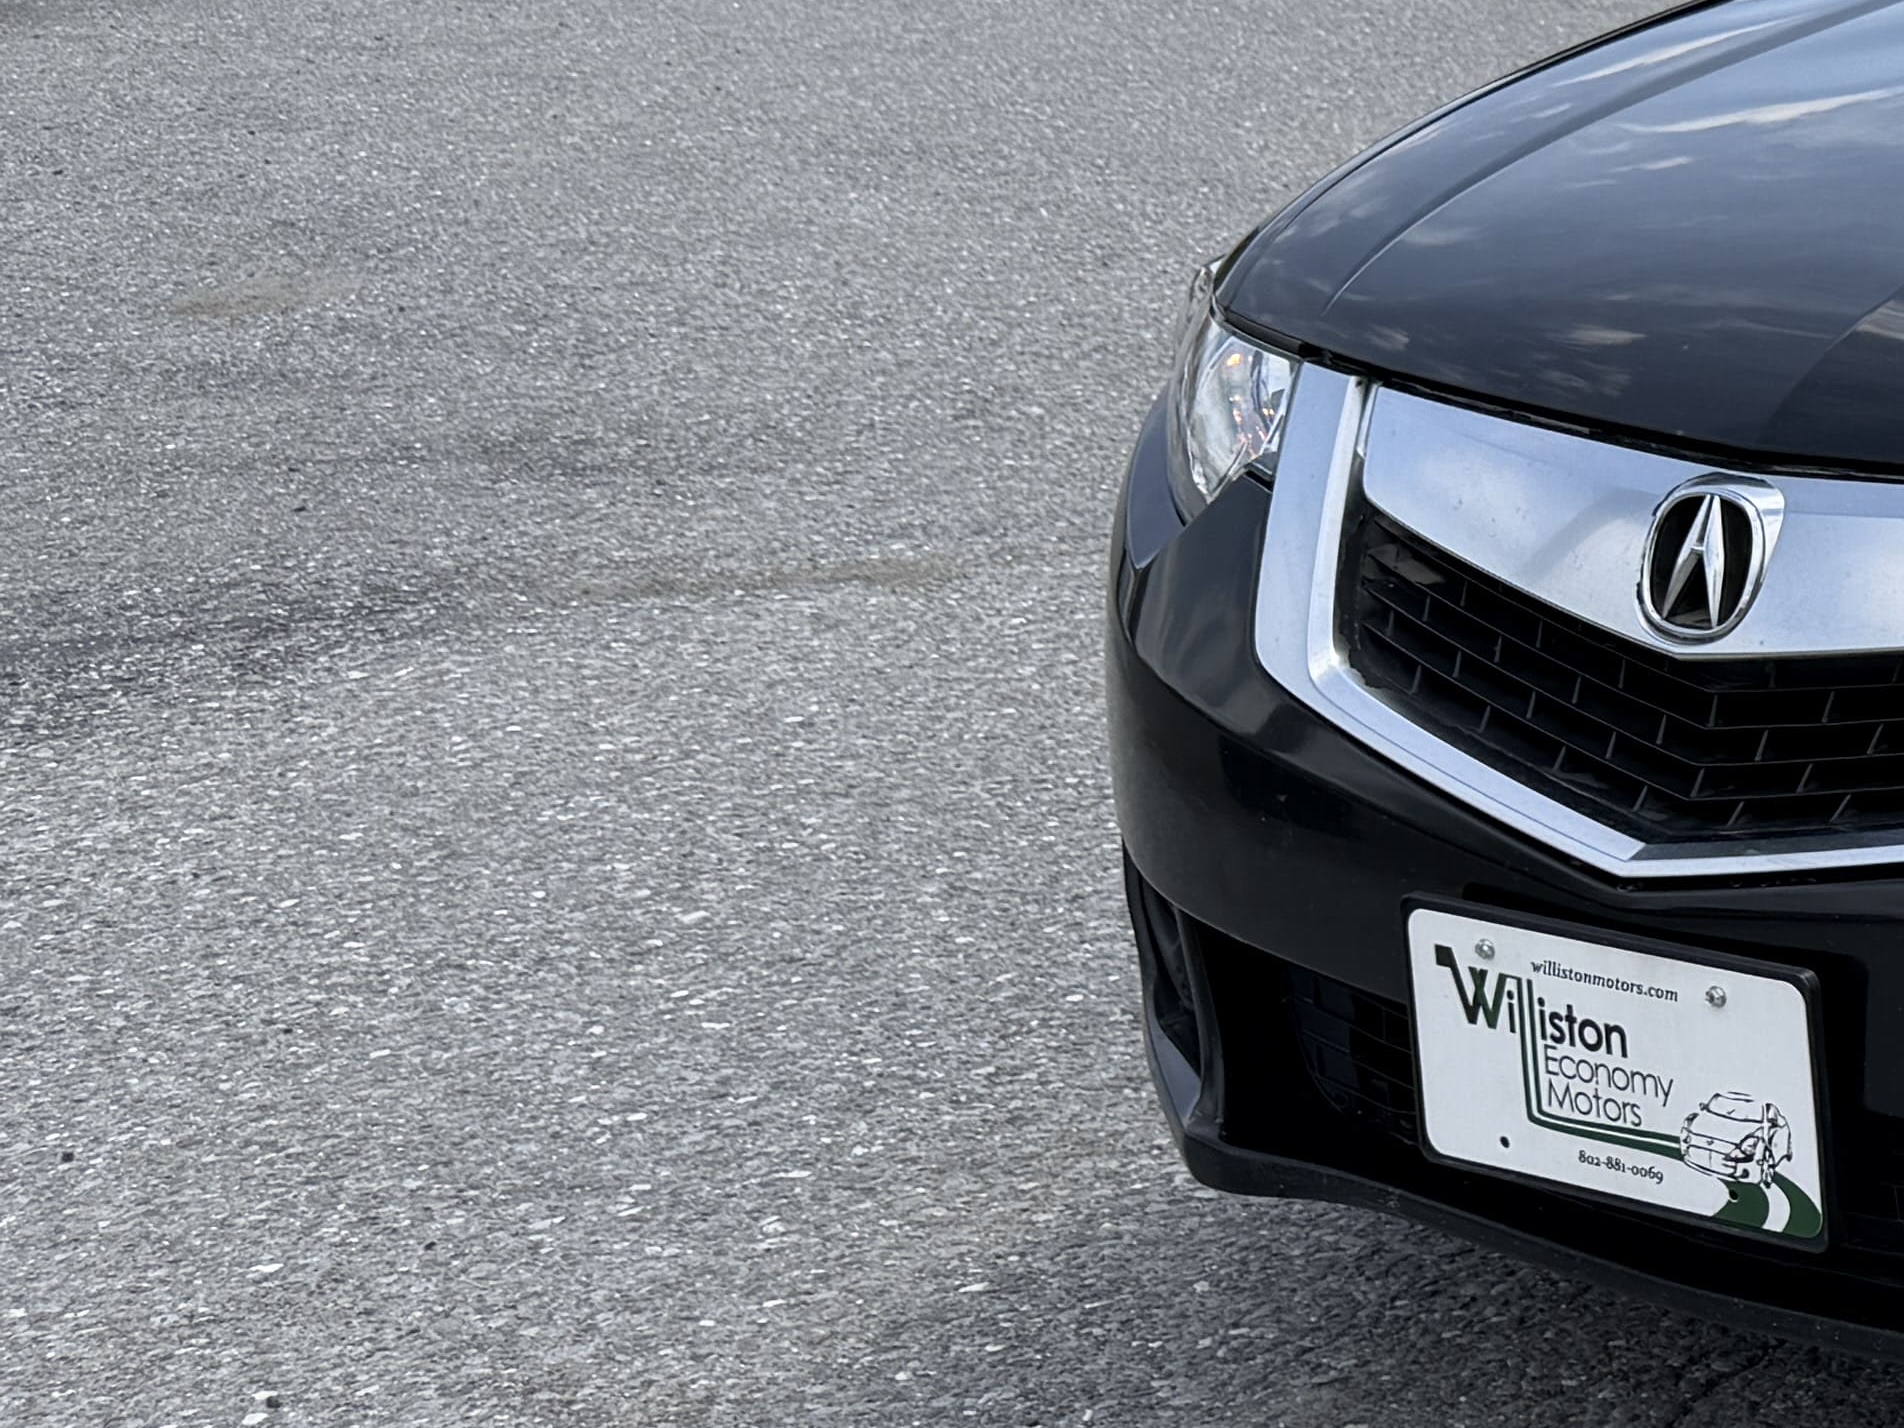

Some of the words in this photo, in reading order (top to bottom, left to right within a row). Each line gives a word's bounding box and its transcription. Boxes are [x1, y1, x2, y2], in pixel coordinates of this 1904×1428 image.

[1434, 943, 1629, 1059] Williston
[1531, 958, 1679, 1003] willistonmotors.com
[1543, 1044, 1675, 1108] Economy
[1546, 1077, 1643, 1128] Motors
[1577, 1149, 1665, 1185] 802-881-0069
